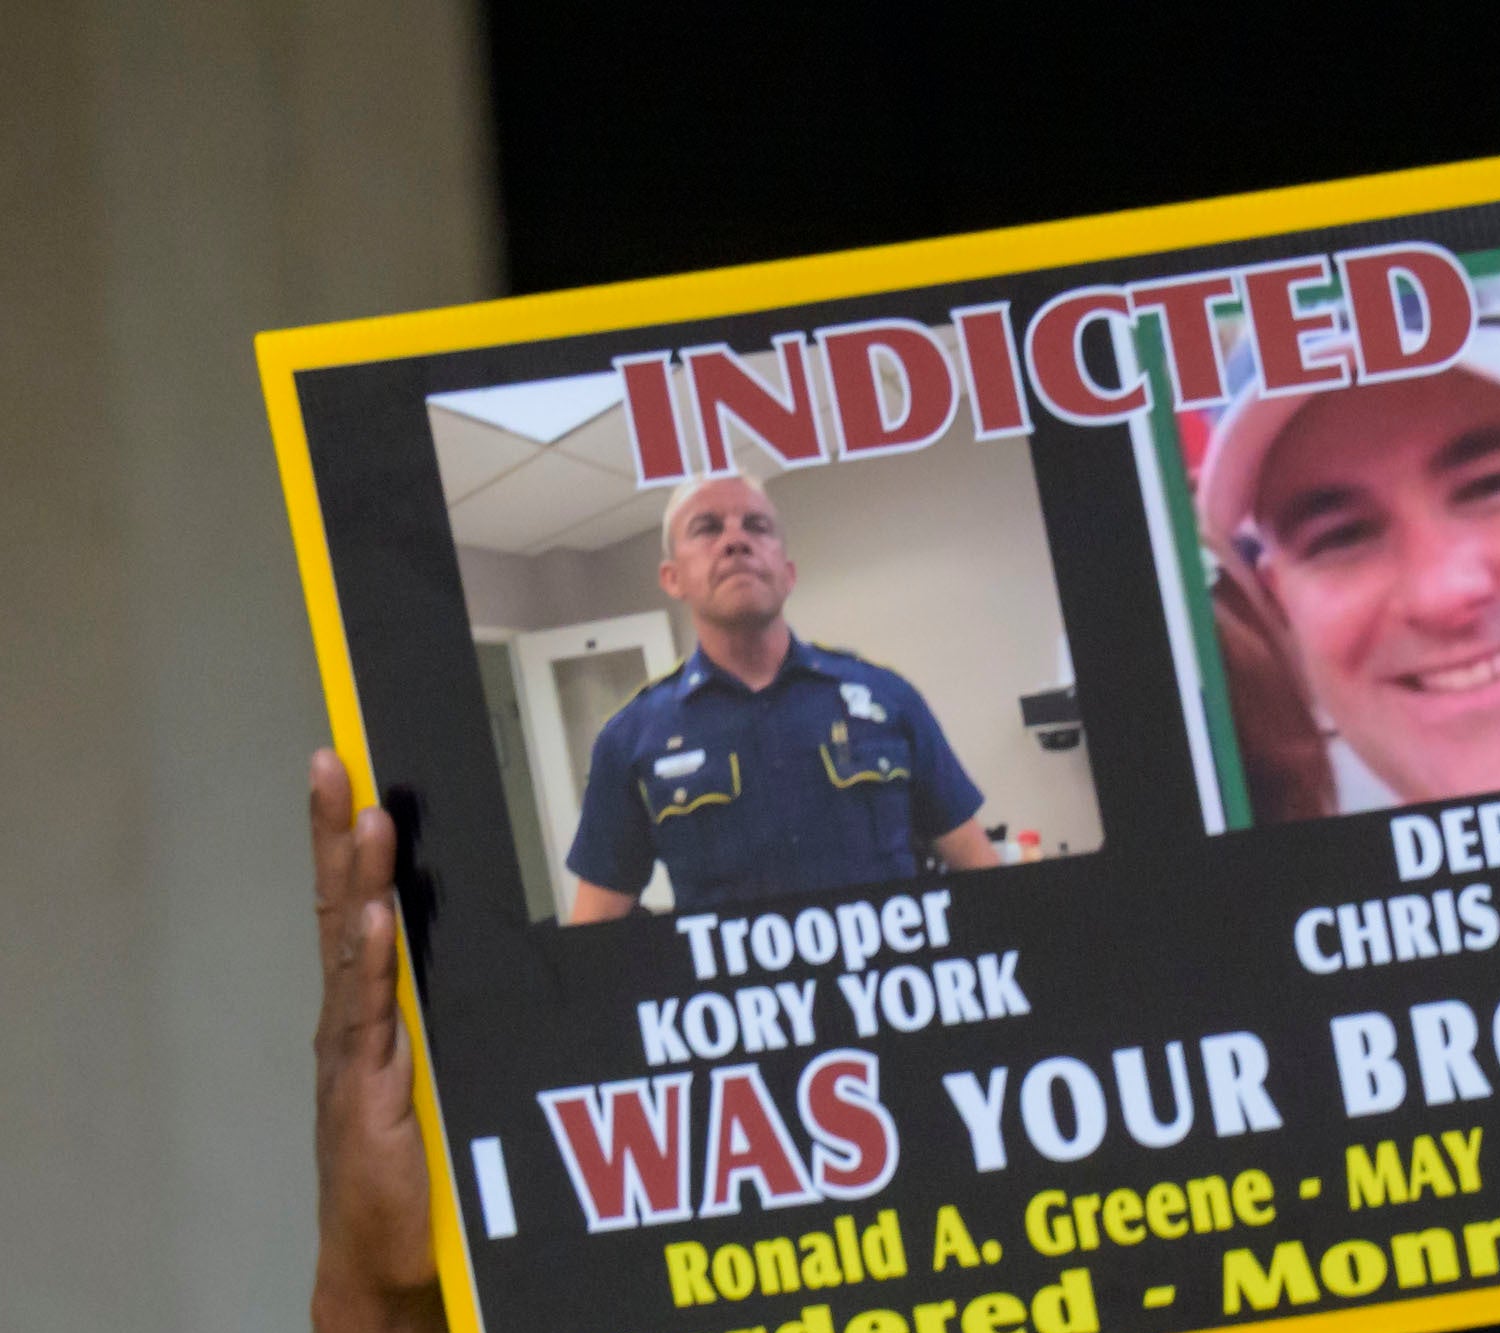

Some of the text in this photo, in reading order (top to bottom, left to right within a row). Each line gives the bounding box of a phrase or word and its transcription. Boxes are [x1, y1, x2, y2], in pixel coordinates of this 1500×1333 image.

[613, 241, 1478, 489] INDICTED
[637, 950, 1031, 1066] KORY YORK
[677, 890, 951, 980] Trooper
[470, 1135, 518, 1240] I
[537, 1048, 900, 1233] WAS
[943, 1030, 1285, 1173] YOUR
[665, 1209, 907, 1308] Ronald
[931, 1204, 1003, 1272] A.
[1025, 1168, 1277, 1257] Greene
[1346, 1126, 1484, 1211] MAY
